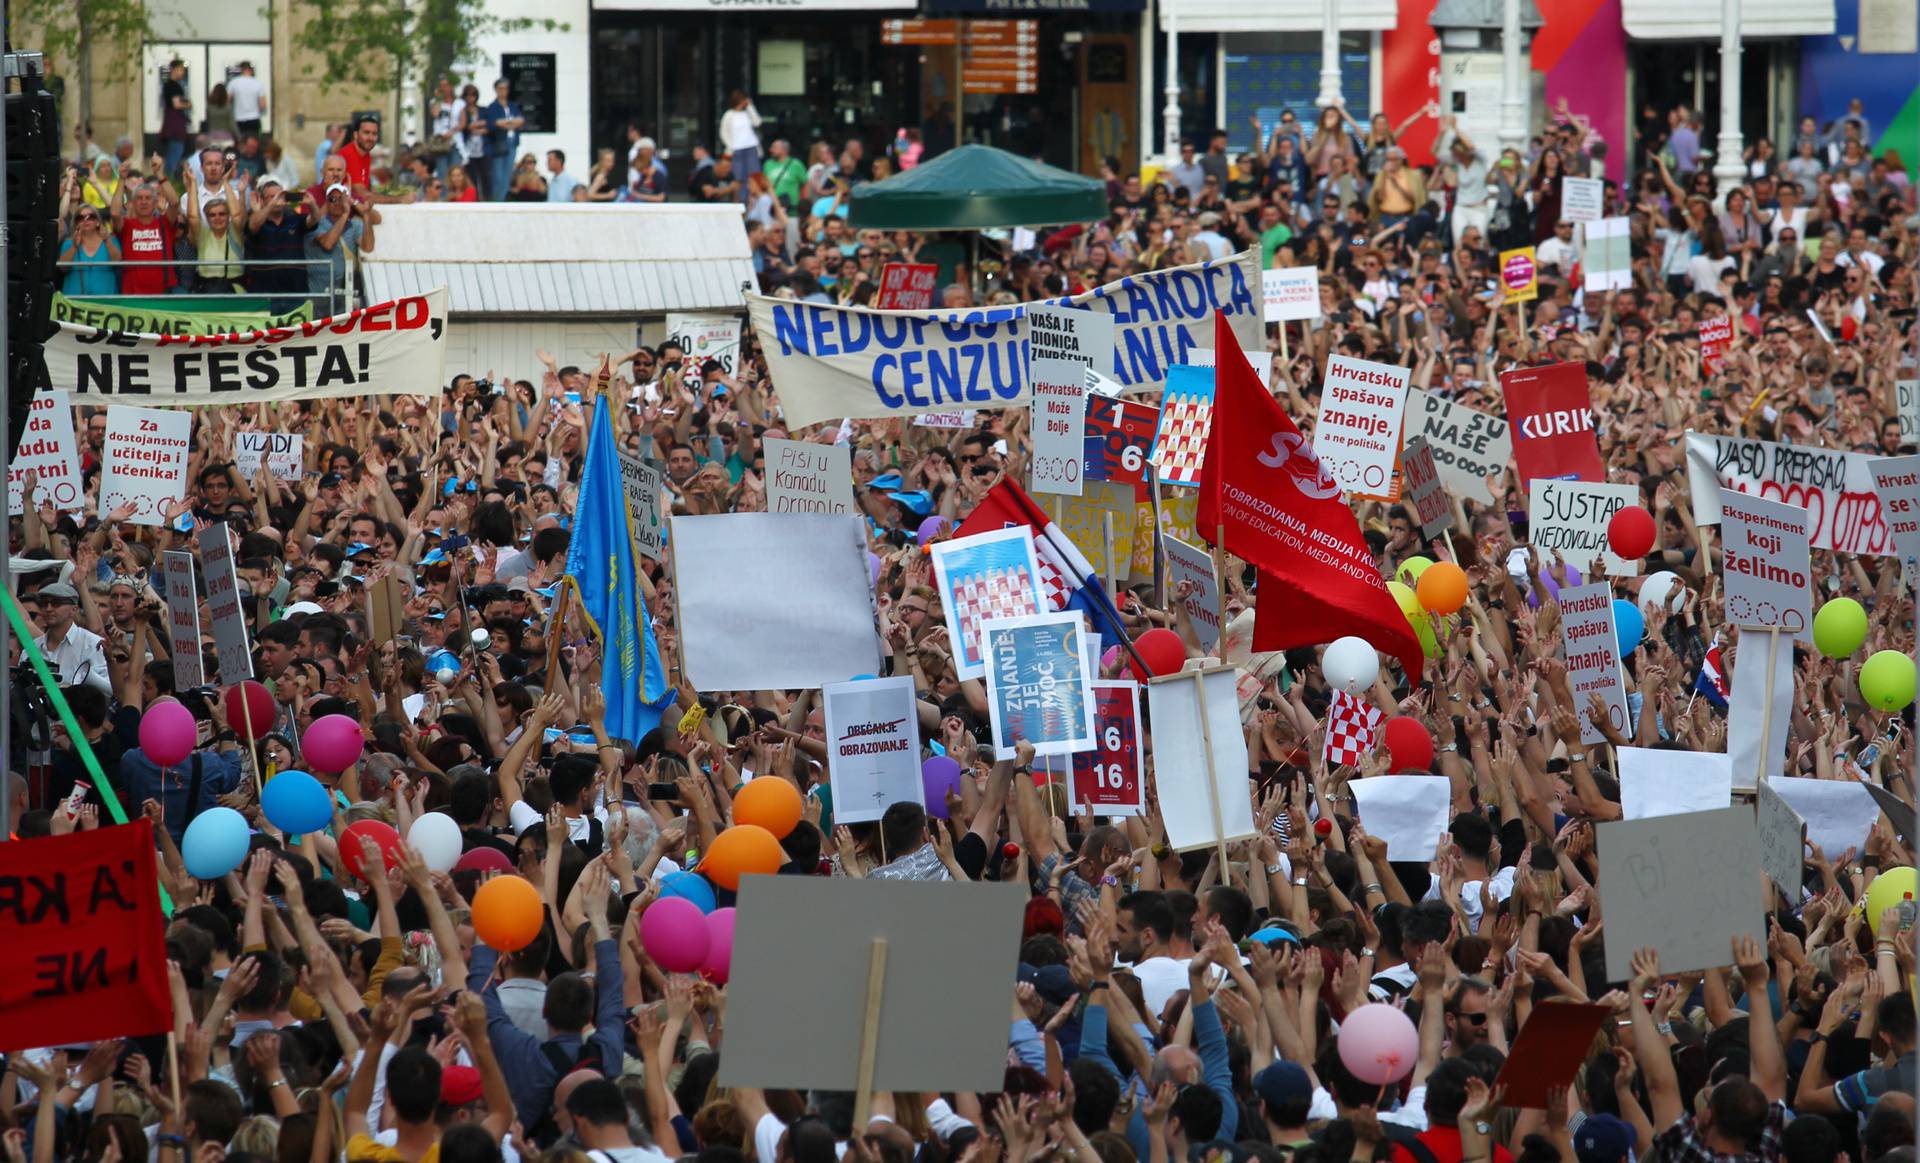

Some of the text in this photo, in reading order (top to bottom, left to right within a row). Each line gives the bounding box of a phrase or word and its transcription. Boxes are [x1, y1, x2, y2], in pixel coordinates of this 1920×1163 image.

[1030, 313, 1075, 333] VAŠA JE
[1032, 330, 1080, 351] DIONICA
[77, 353, 151, 394] NE
[173, 343, 370, 393] FEŠTA!
[1331, 363, 1403, 389] Hrvatsku
[1036, 382, 1083, 397] #Hrvatska
[1332, 386, 1395, 408] spašava
[1047, 401, 1071, 414] Može
[1425, 396, 1506, 439] DI SU
[29, 418, 52, 432] da
[139, 420, 158, 432] Za
[925, 413, 966, 426] CONTROL
[1047, 420, 1070, 435] Bolje
[1322, 408, 1393, 438] znanje,
[109, 432, 188, 447] dostojanstvo
[243, 434, 292, 453] VLADI
[1324, 433, 1386, 451] a ne politika
[1424, 416, 1490, 455] NAŠE
[18, 438, 60, 457] udu
[112, 448, 181, 464] učitelja i
[8, 460, 68, 482] srtni
[112, 464, 179, 480] učenika!
[818, 456, 828, 472] u
[1773, 446, 1847, 494] PREPISAO,
[775, 469, 827, 494] Kanadu
[1891, 500, 1910, 513] se
[1229, 485, 1307, 536] OBRAZOVANJA,
[1309, 528, 1354, 558] MEDIJA
[1722, 504, 1805, 536] Eksperiment
[1248, 513, 1304, 553] EDUCATION,
[1305, 545, 1339, 570] MEDIA
[1340, 564, 1365, 580] AND
[1747, 528, 1781, 555] koji
[1724, 549, 1806, 589] želimo
[181, 581, 189, 598] da
[208, 579, 218, 596] se
[1560, 593, 1608, 615] Hrvatsku
[173, 606, 194, 626] budu
[1567, 620, 1609, 643] spašava
[175, 638, 198, 656] sretni
[1568, 645, 1616, 672] znanje,
[1575, 677, 1616, 692] a ne politika
[1022, 685, 1041, 709] JE
[848, 721, 898, 737] OBEĆANJE
[839, 739, 909, 757] OBRAZOVANJE
